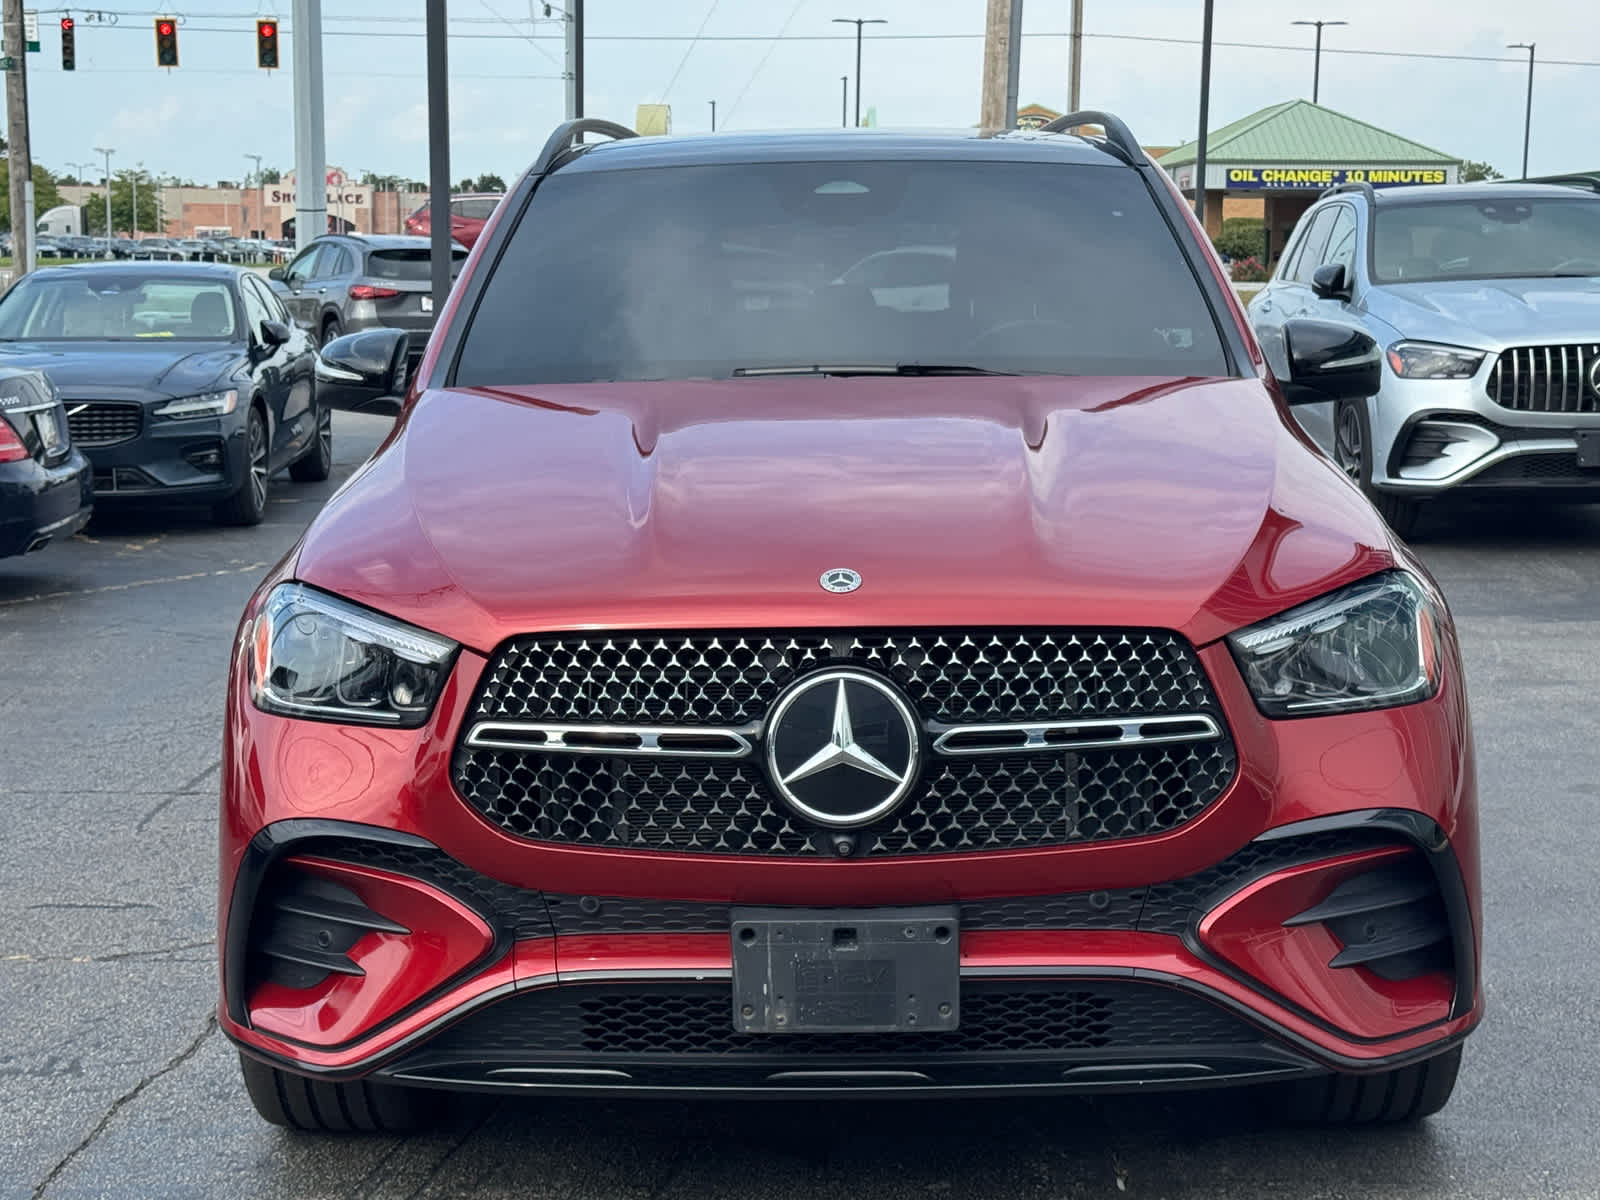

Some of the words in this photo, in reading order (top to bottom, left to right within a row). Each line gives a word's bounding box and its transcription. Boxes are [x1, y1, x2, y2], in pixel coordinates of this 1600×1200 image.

[1230, 169, 1258, 182] OIL
[1345, 170, 1365, 183] 10
[1368, 170, 1445, 183] MINUTES
